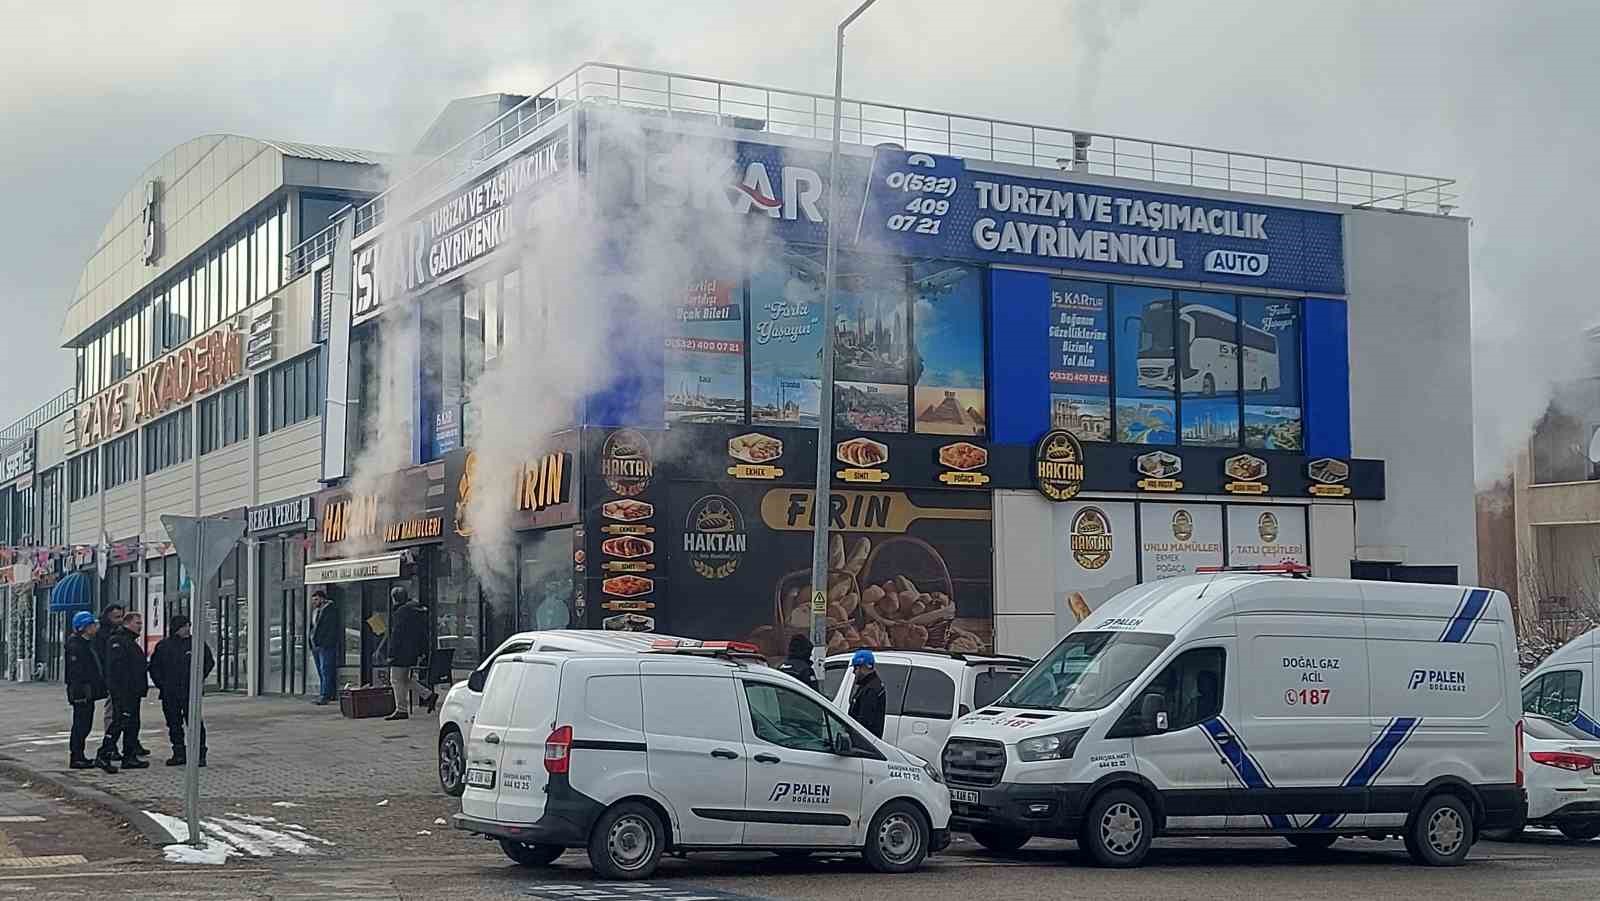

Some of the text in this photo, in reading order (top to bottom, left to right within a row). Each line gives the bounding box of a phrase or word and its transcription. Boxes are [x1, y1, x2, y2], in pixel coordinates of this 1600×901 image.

[886, 172, 957, 198] 0(532)
[469, 184, 484, 217] VE
[906, 197, 950, 217] 409
[1074, 192, 1113, 223] VE
[1113, 197, 1269, 240] TAŞIMACILIK
[971, 217, 1184, 270] GAYRİMENKUL
[1213, 252, 1261, 273] AUTO
[602, 458, 653, 477] HAKTAN
[1038, 460, 1084, 481] HAKTAN
[683, 533, 747, 552] HAKTAN
[1071, 535, 1112, 551] HAKTAN
[1282, 655, 1340, 669] DOĞAL GAZ
[1301, 670, 1324, 683] ACİL
[1429, 670, 1465, 684] PALEN
[1299, 689, 1330, 705] 187
[793, 783, 831, 797] PALEN
